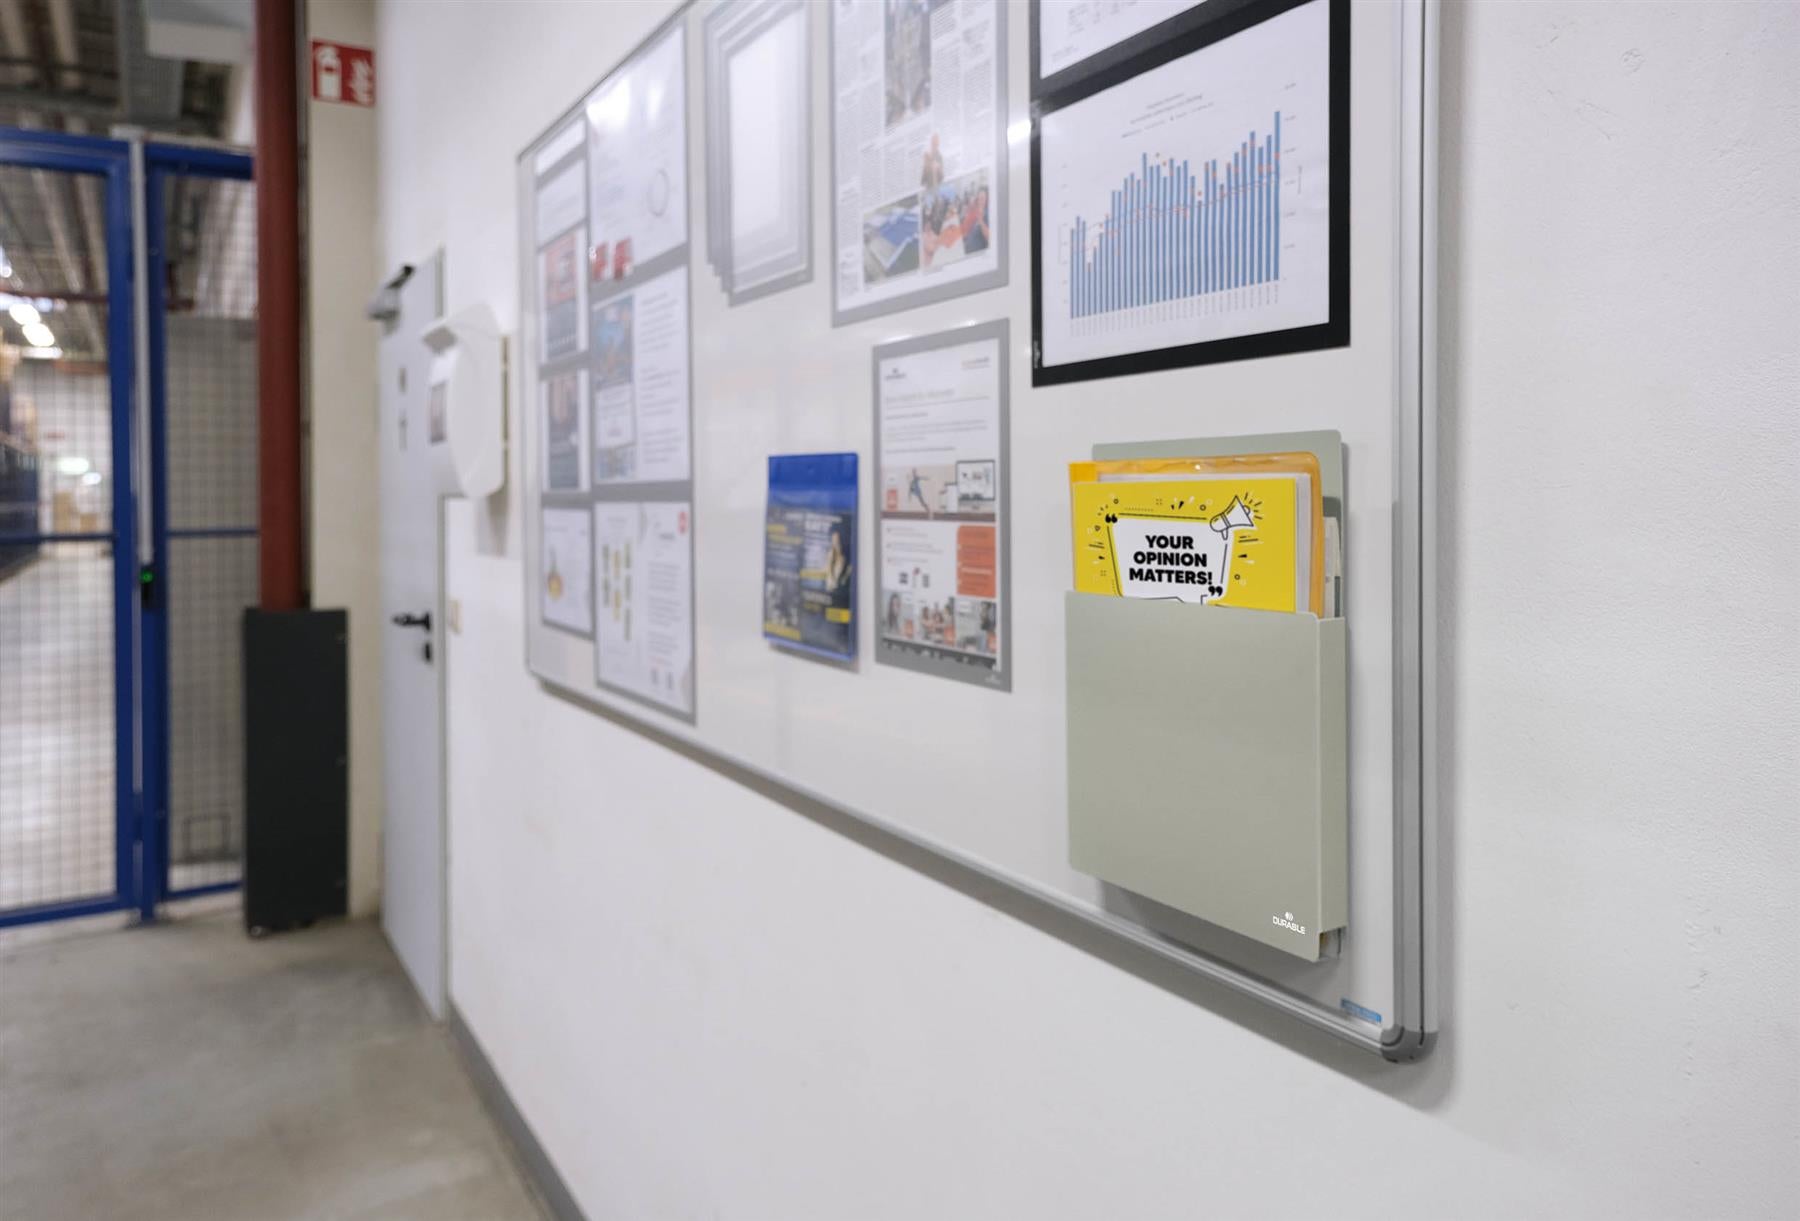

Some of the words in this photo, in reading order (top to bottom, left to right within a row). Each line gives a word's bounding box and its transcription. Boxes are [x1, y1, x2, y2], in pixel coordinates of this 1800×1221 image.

[1145, 534, 1194, 549] YOUR
[1133, 551, 1207, 567] OPINION
[1129, 567, 1212, 585] MATTERS!
[1272, 915, 1305, 934] DURABLE
